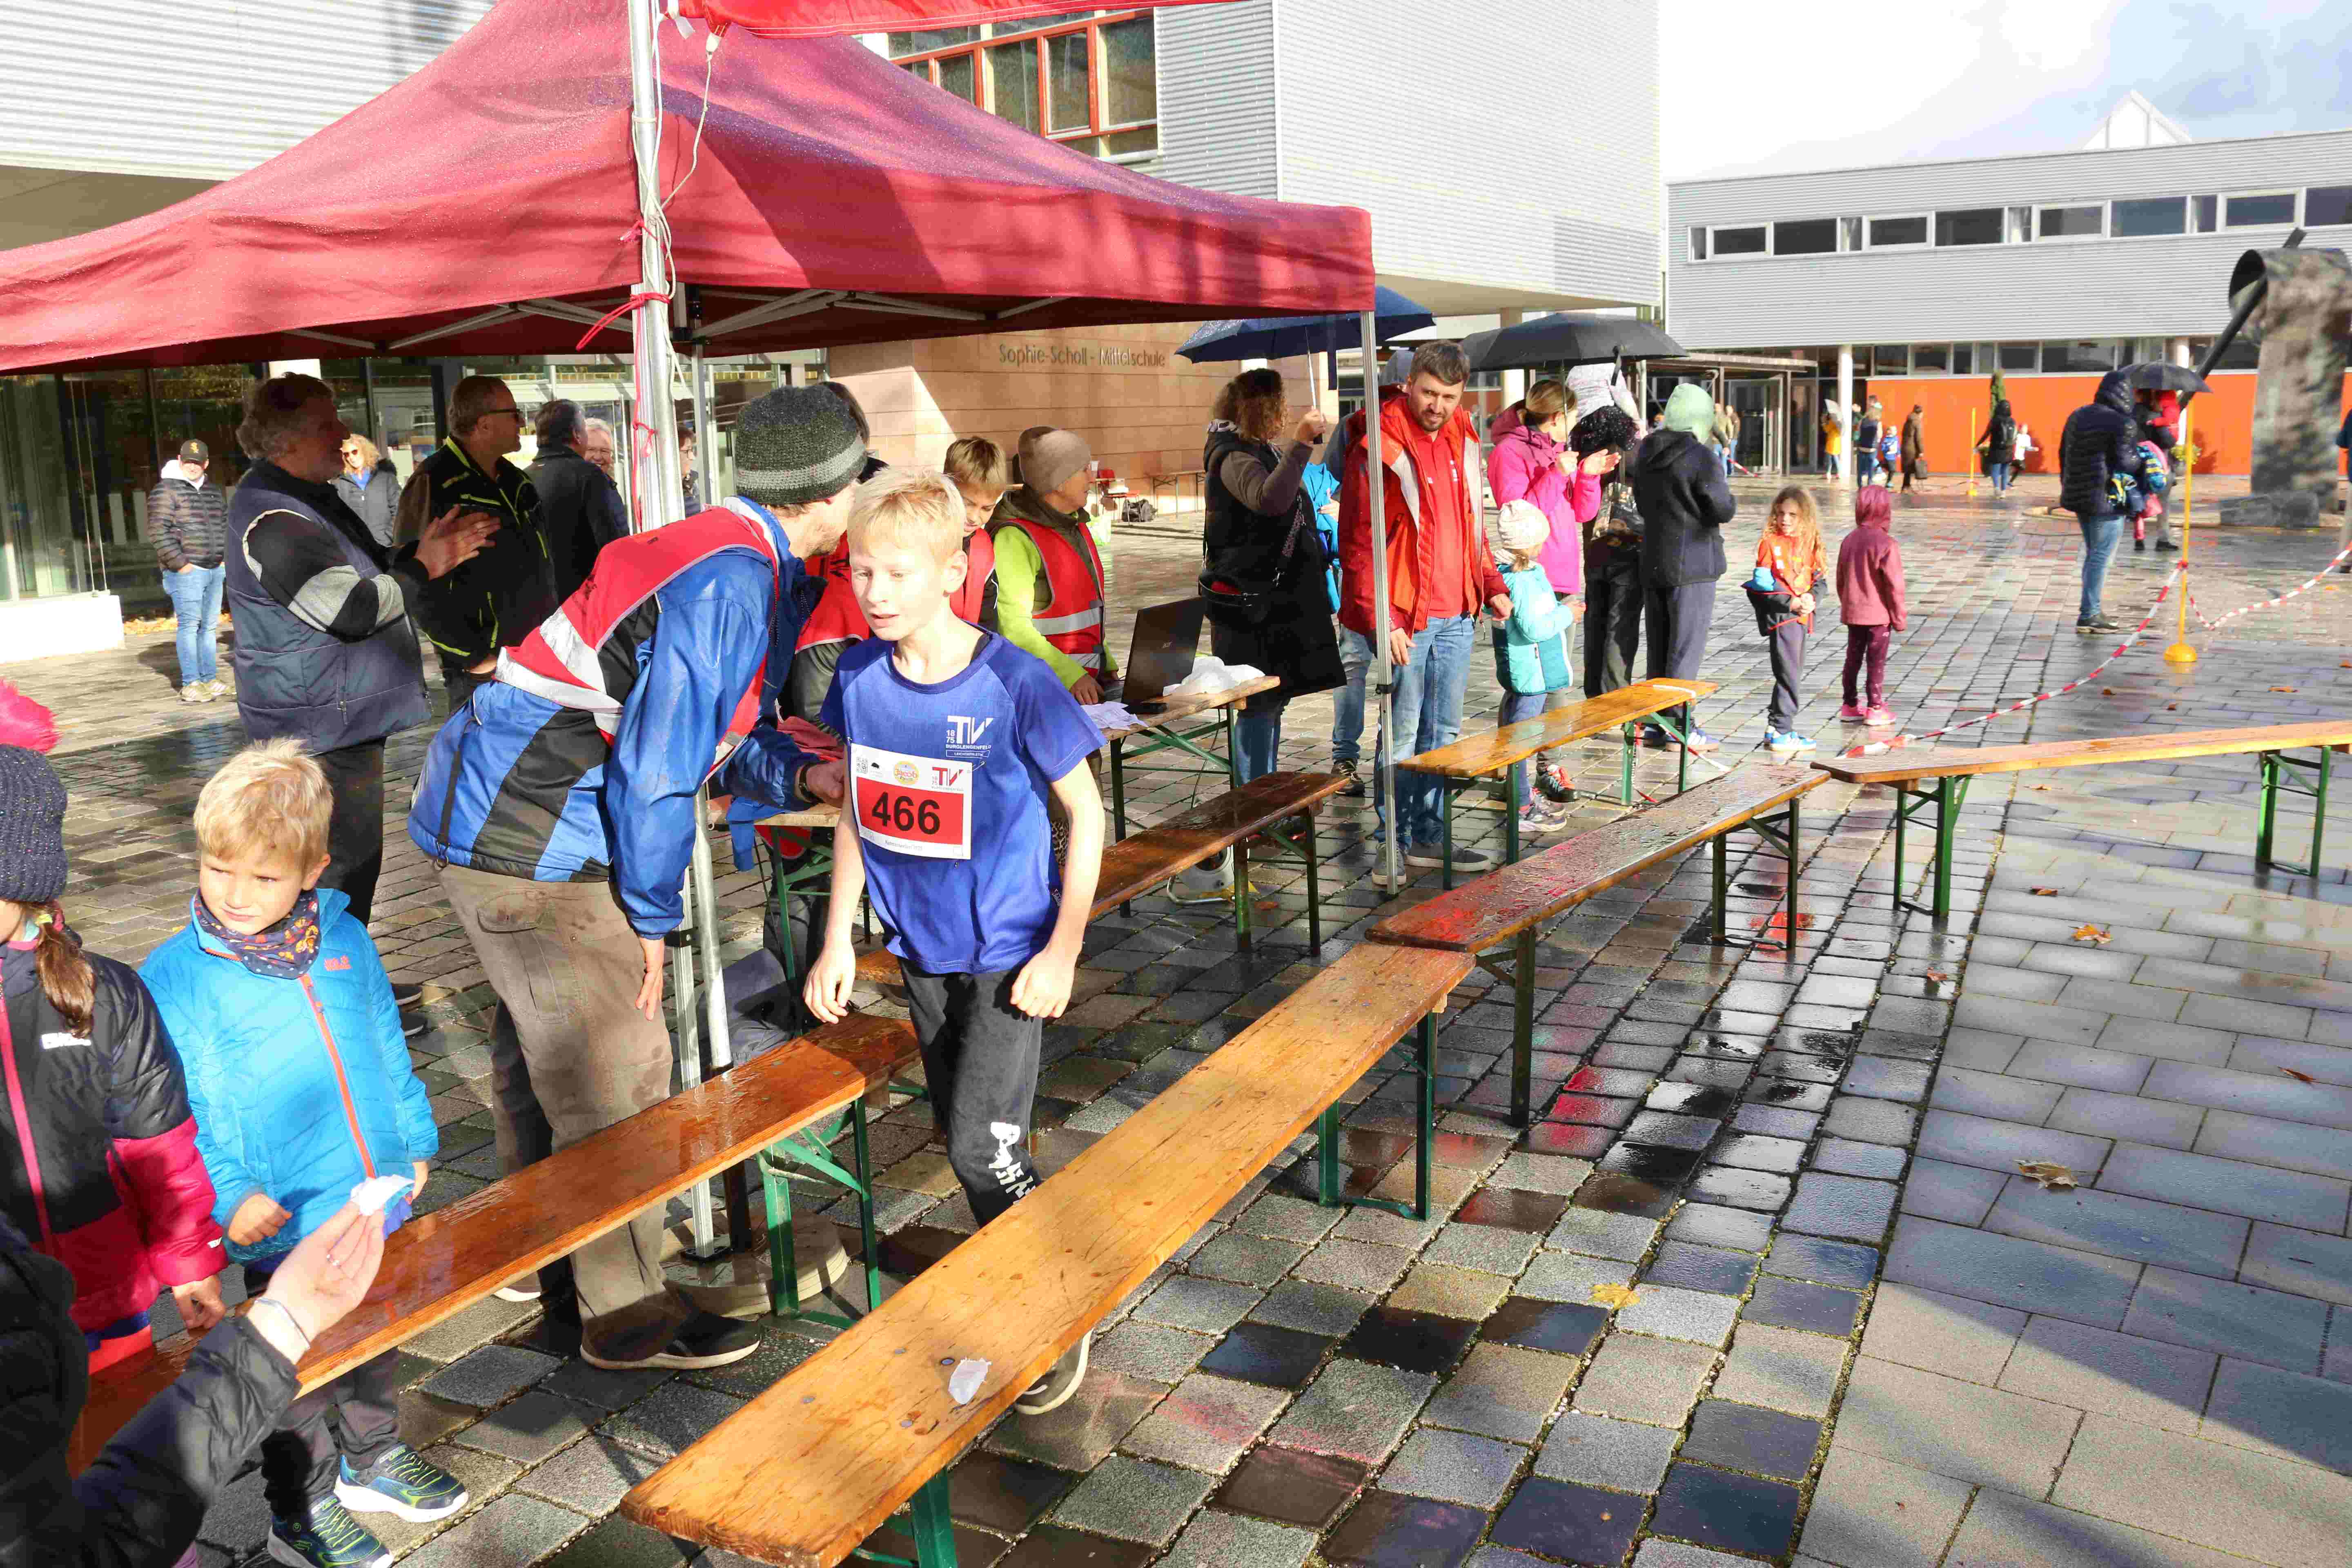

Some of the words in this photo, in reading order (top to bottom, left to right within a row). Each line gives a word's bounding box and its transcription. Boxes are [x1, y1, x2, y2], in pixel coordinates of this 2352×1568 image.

[999, 343, 1087, 366] Sophie-Scholl
[1100, 346, 1165, 366] Mittelschule
[947, 715, 993, 744] TV
[932, 766, 964, 786] TV
[872, 791, 940, 835] 466
